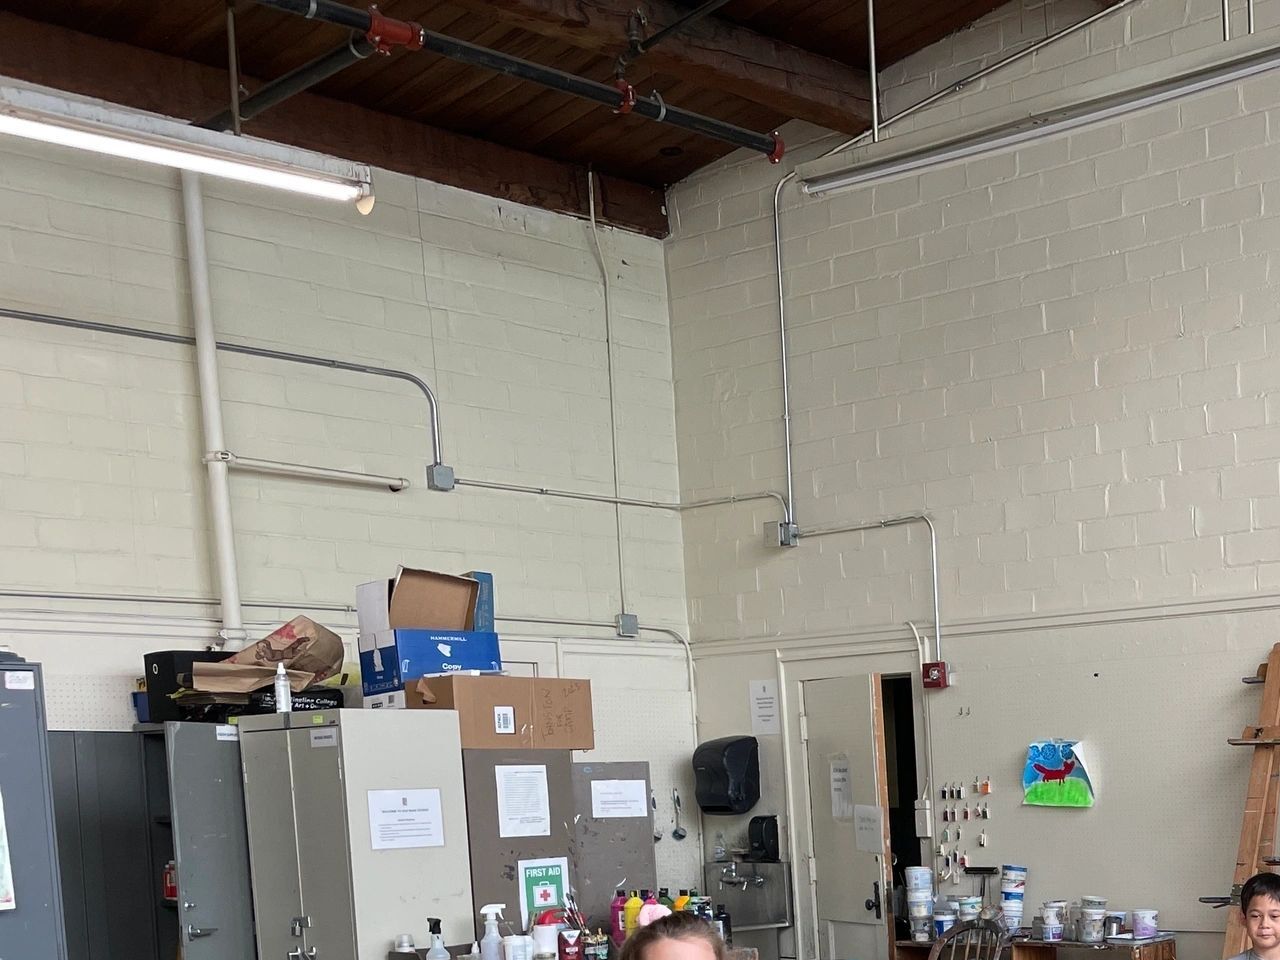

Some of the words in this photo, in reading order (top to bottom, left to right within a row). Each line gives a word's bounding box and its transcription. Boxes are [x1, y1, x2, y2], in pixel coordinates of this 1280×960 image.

[442, 662, 462, 671] Copy
[526, 867, 547, 878] FIRST
[548, 866, 561, 876] AID
